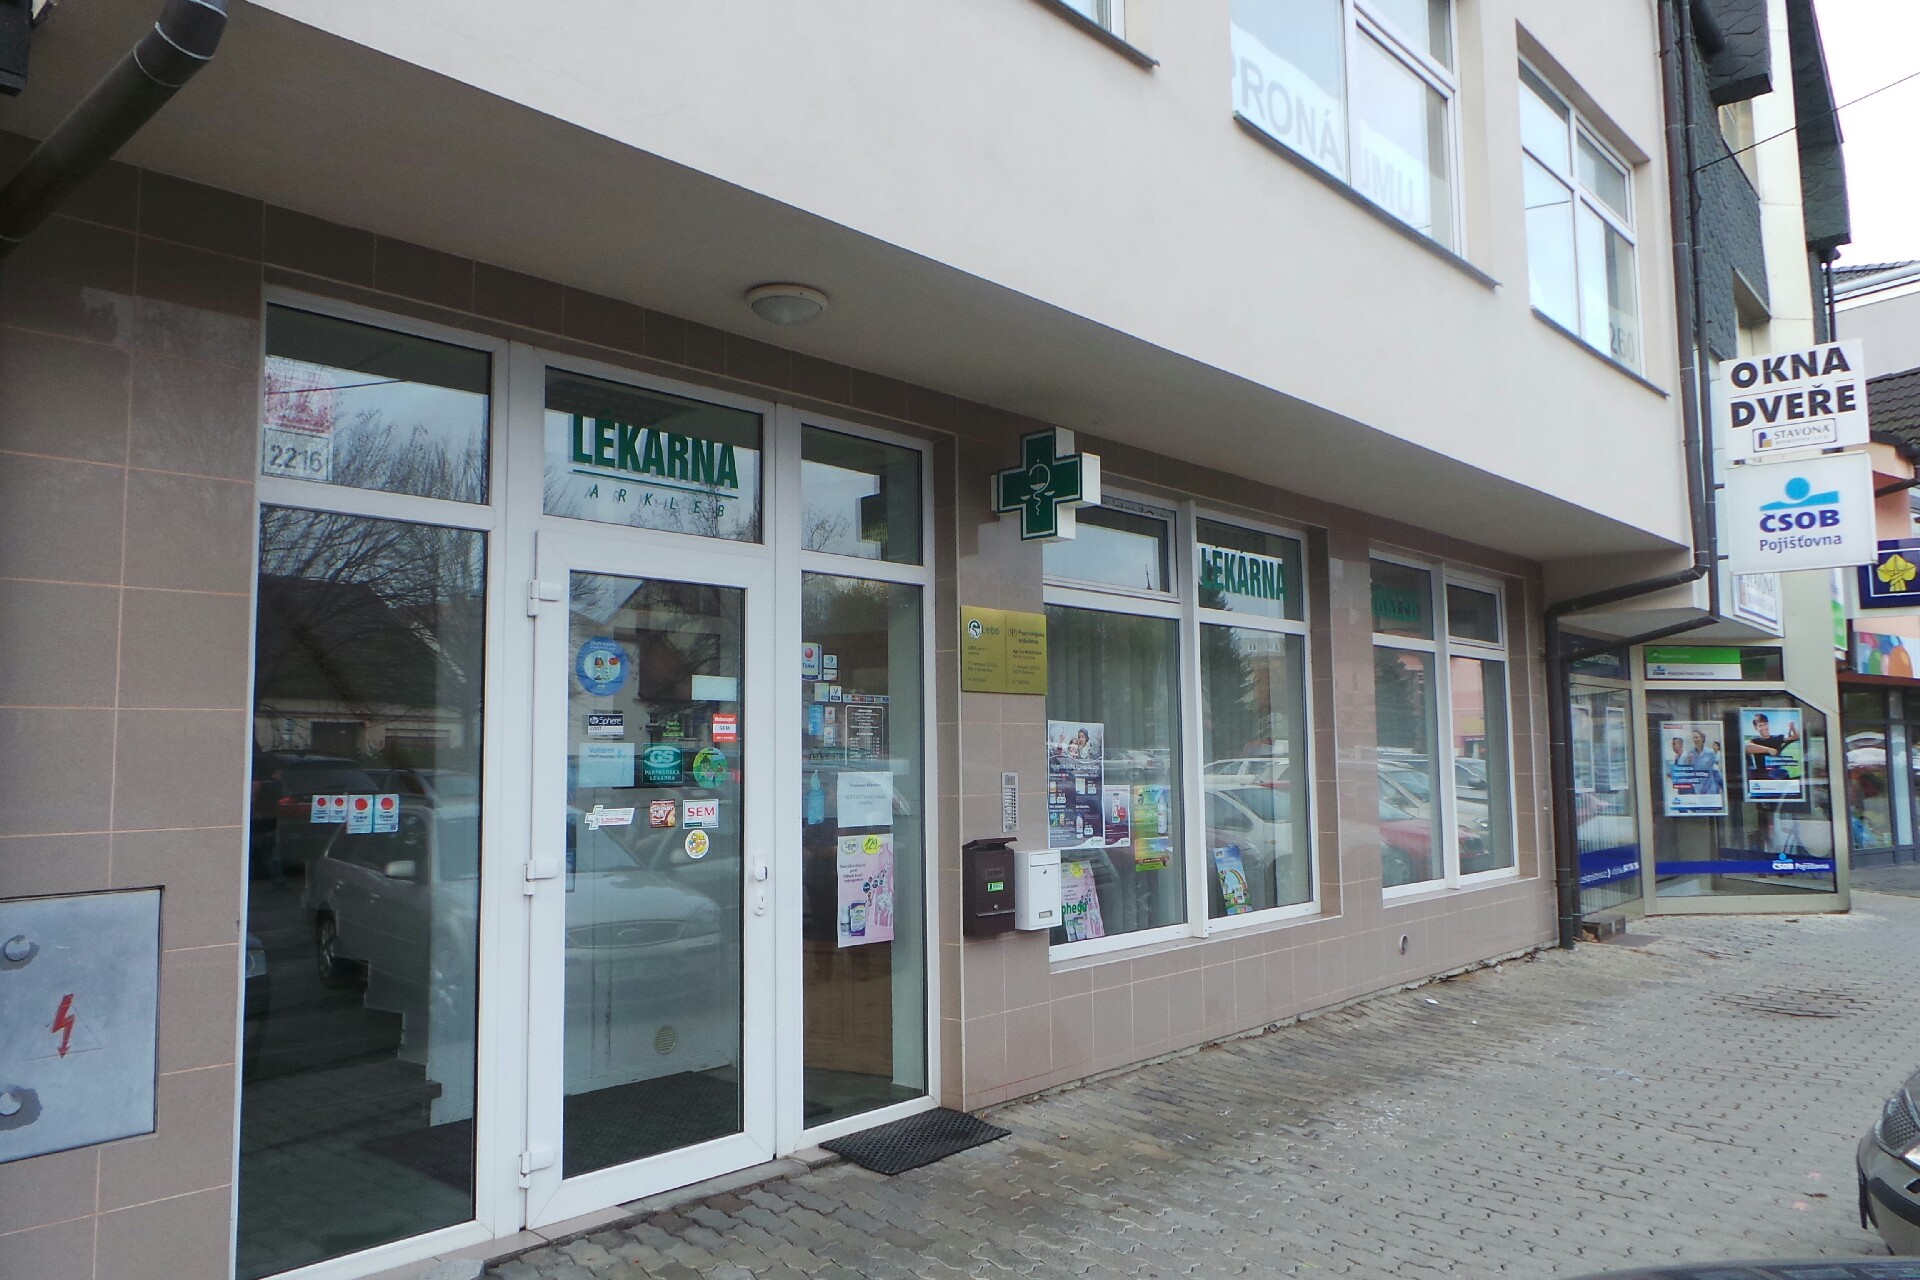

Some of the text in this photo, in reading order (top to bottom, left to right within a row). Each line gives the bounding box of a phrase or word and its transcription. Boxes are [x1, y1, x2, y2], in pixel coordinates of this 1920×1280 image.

[1731, 346, 1852, 389] OKNA
[1730, 383, 1857, 428] DVEŘE
[1774, 423, 1831, 440] STAVONA
[269, 444, 323, 473] 2216
[588, 483, 726, 518] ARKLEB
[1760, 509, 1840, 533] ČSOB
[1759, 534, 1842, 553] Pojišťovna
[650, 750, 675, 764] GS
[687, 806, 715, 817] SEM
